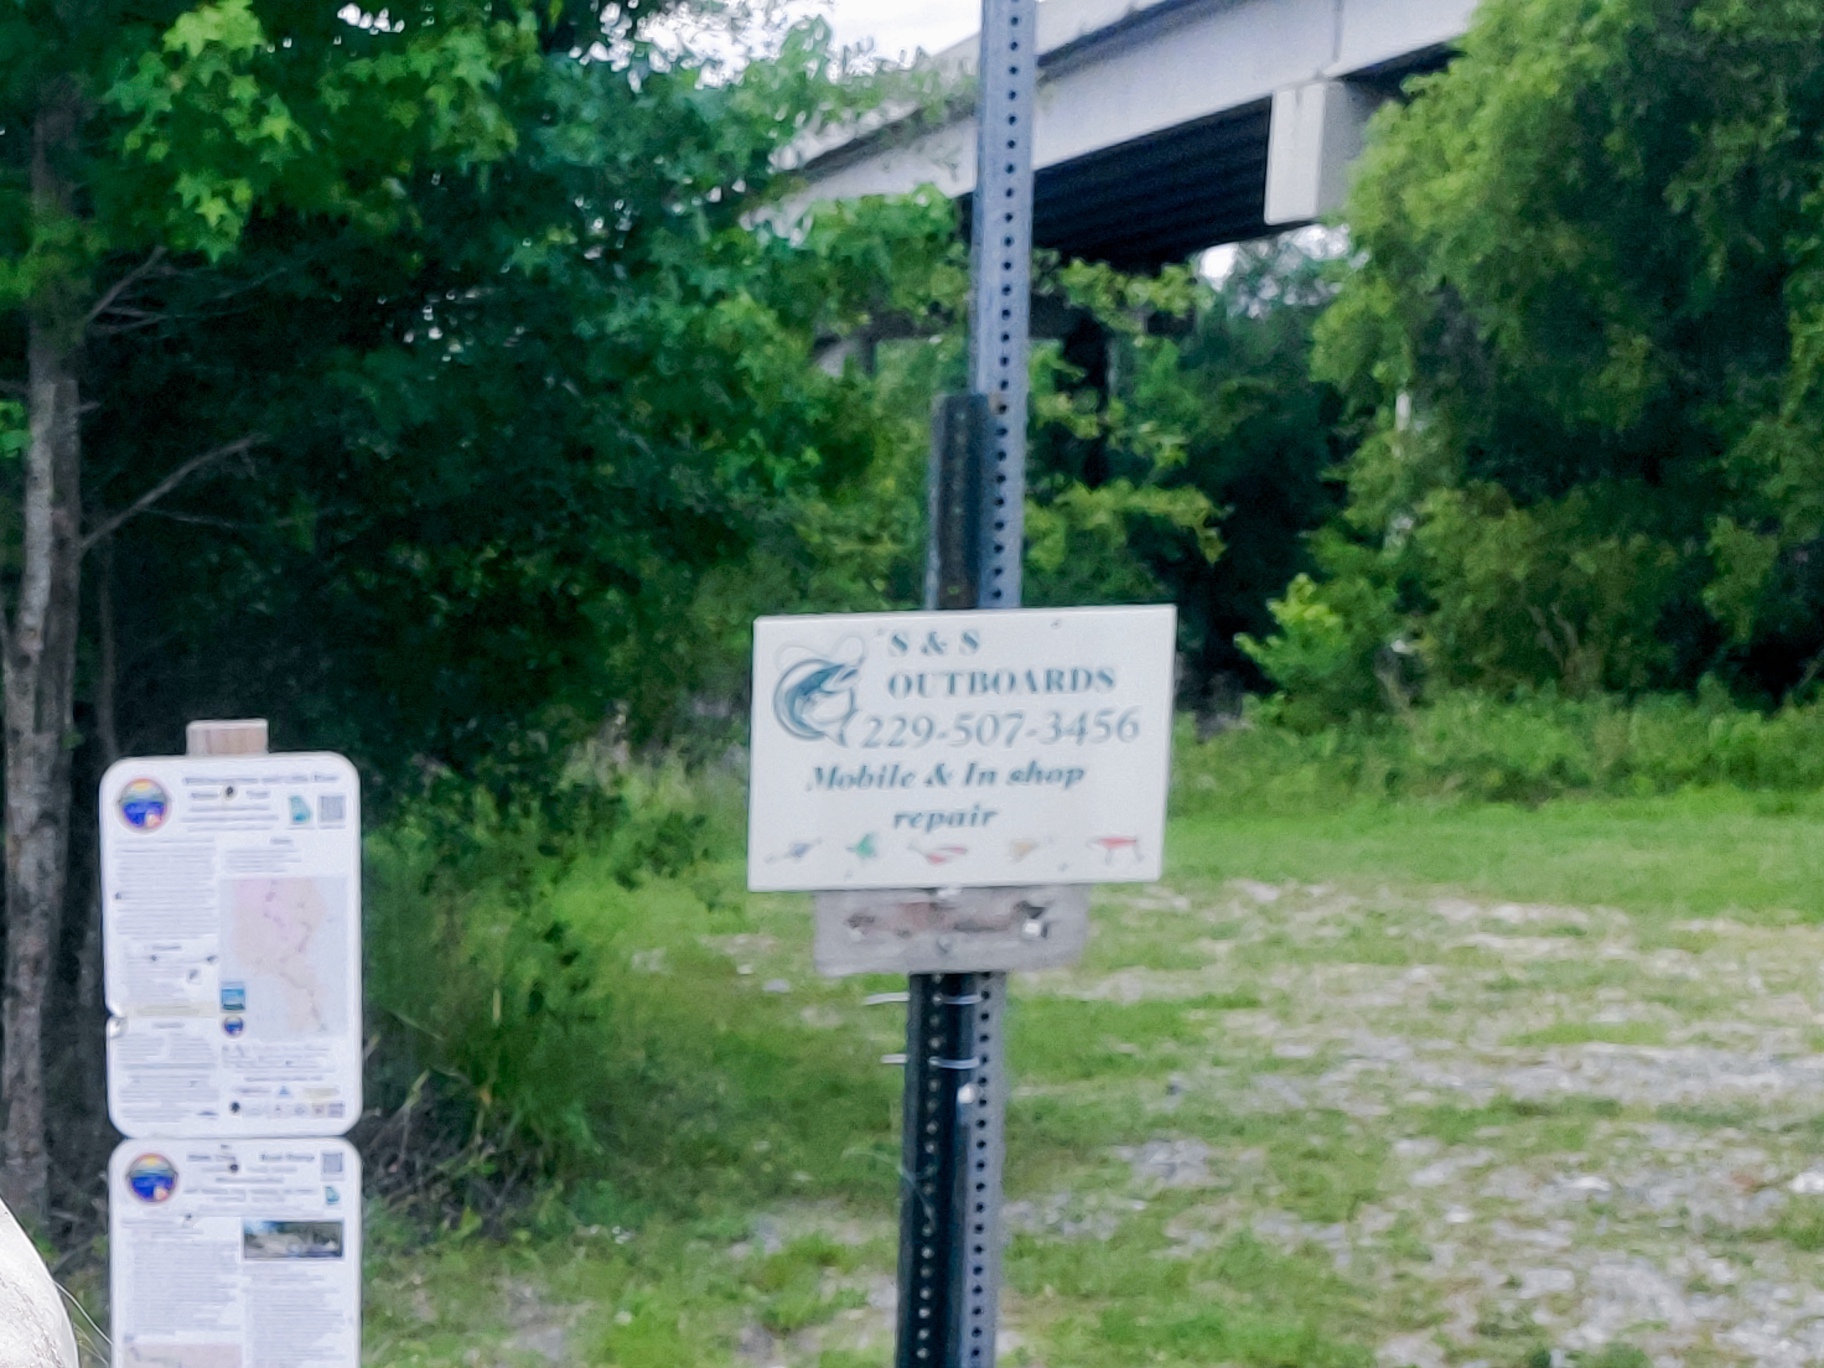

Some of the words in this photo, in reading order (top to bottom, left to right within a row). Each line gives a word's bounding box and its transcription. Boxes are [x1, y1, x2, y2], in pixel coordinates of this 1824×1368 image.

[889, 630, 909, 657] S
[921, 631, 947, 656] &
[960, 630, 981, 655] S
[887, 666, 1116, 700] OUTBOARDS
[861, 708, 1140, 749] 229-507-3456
[807, 764, 915, 791] Mobile
[922, 762, 953, 787] &
[1005, 760, 1086, 790] shop
[893, 804, 1000, 833] repair
